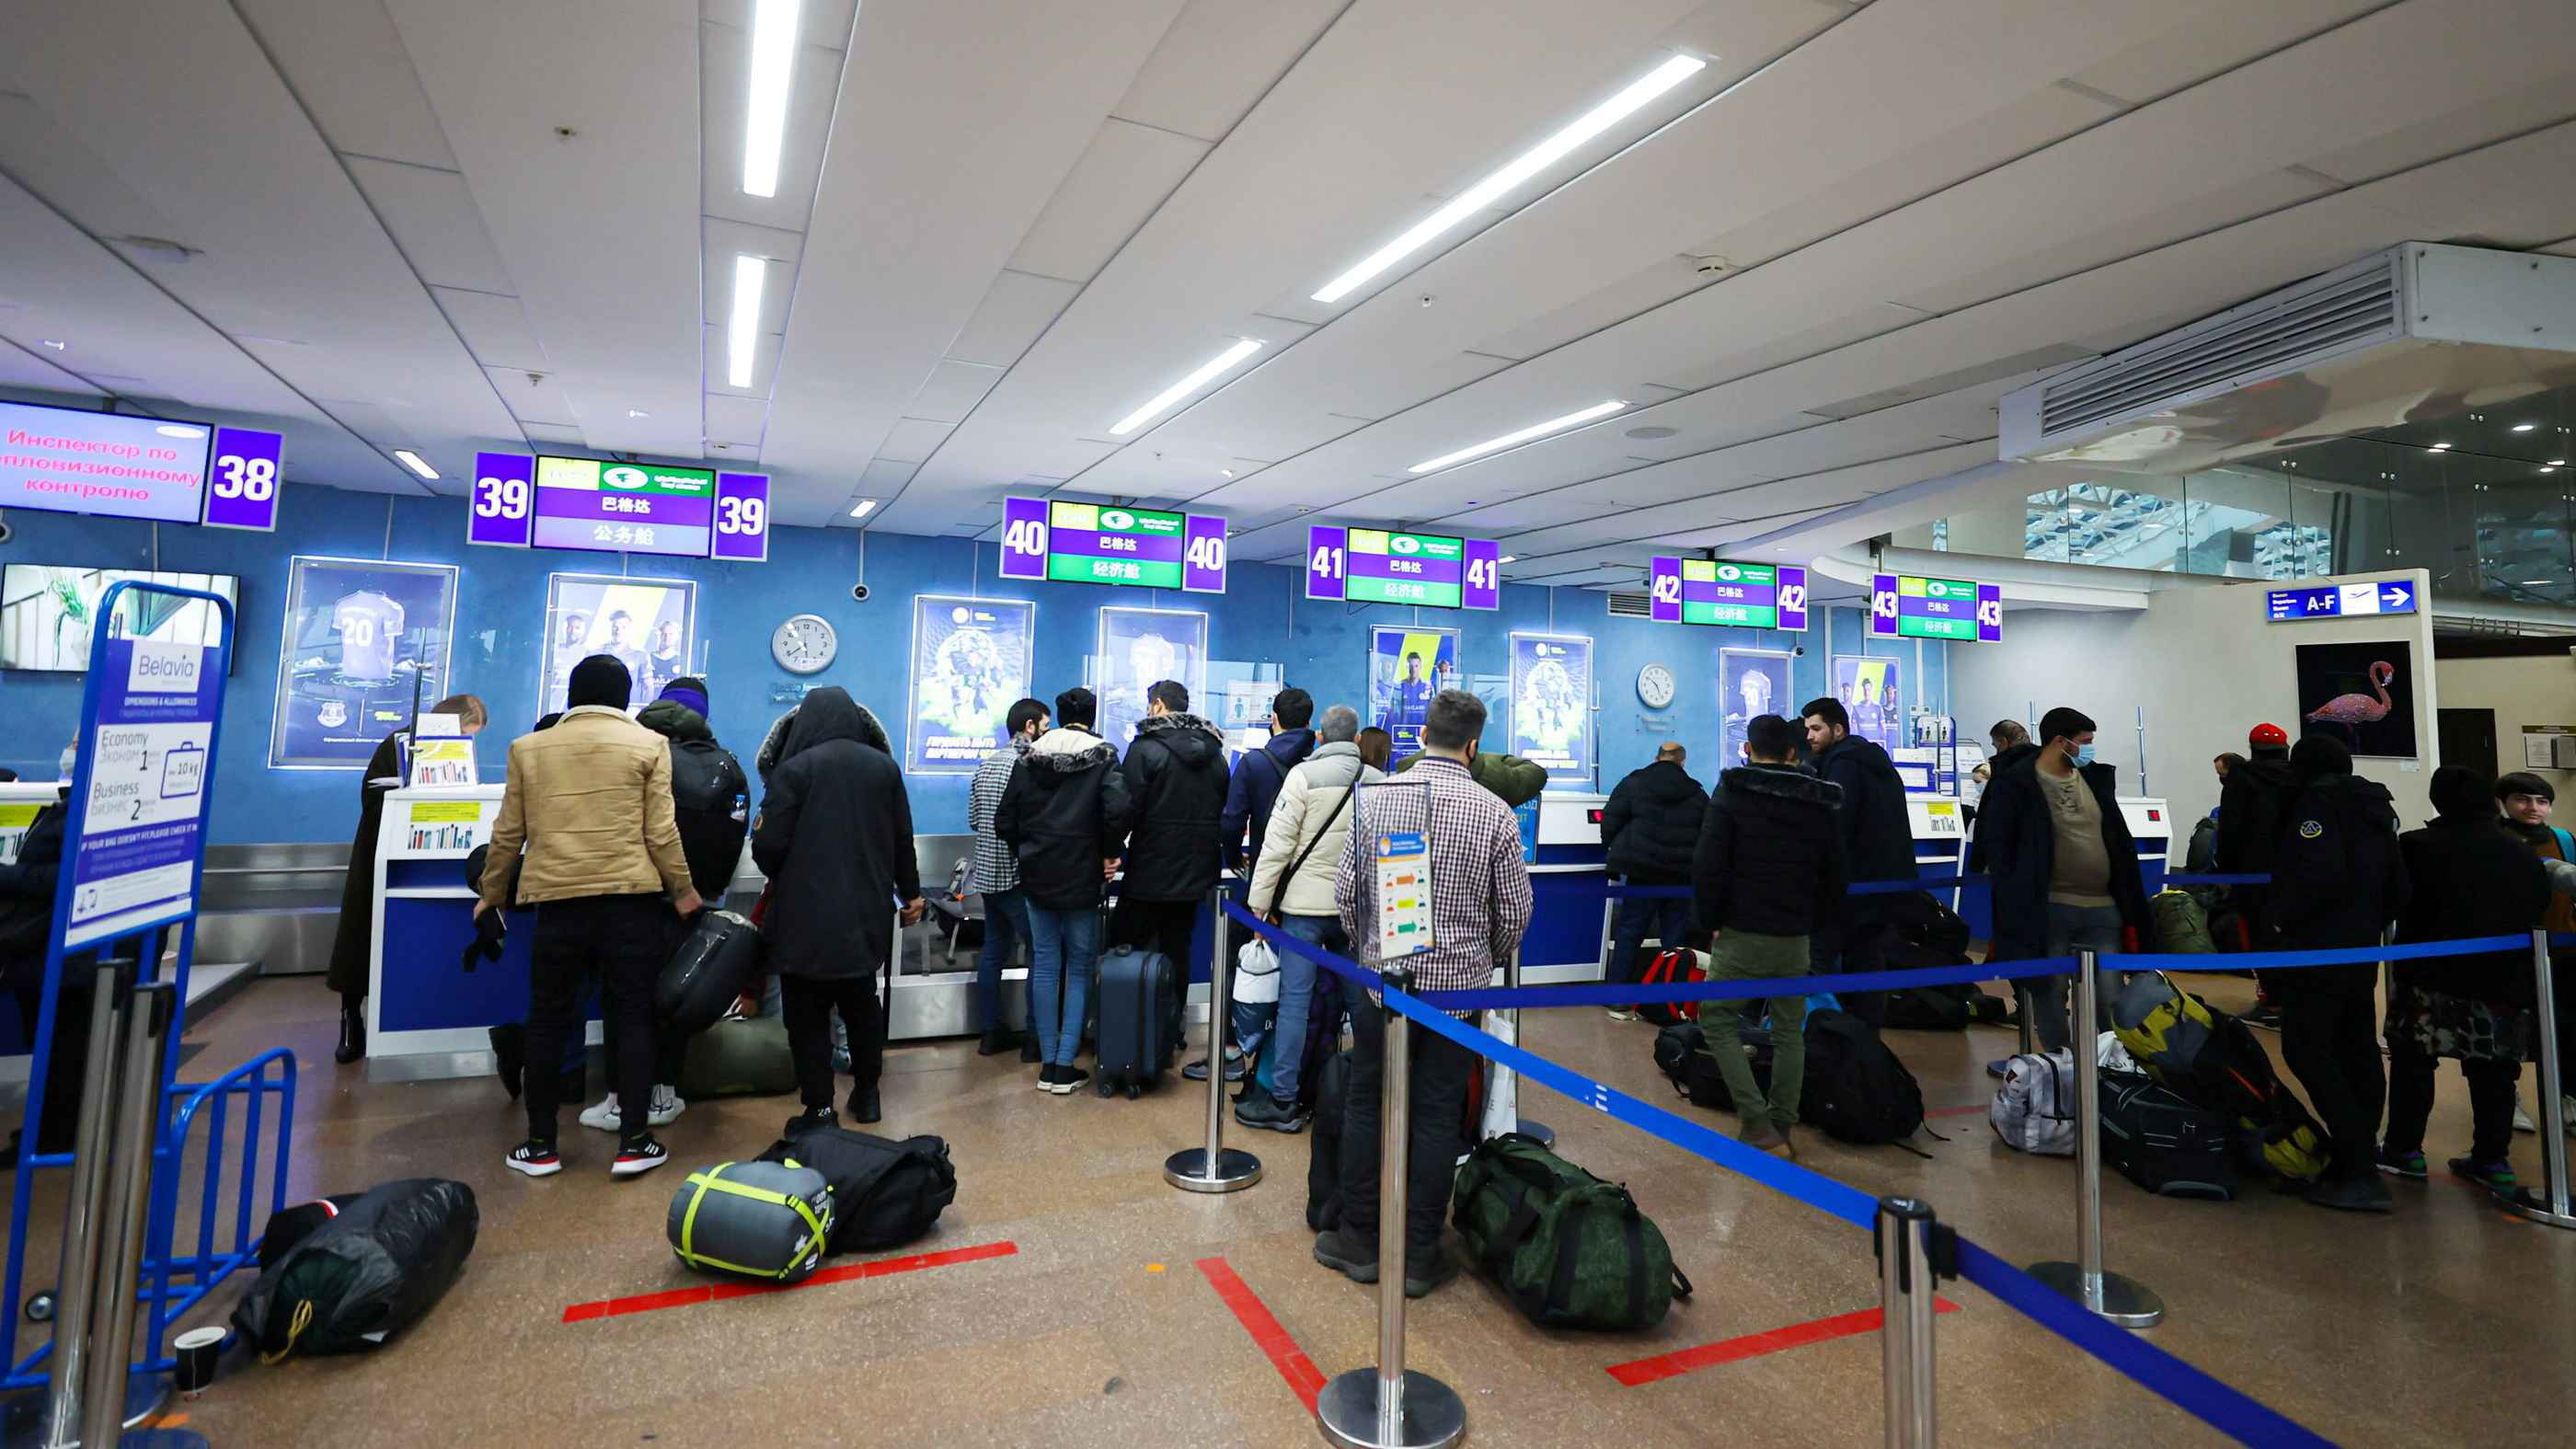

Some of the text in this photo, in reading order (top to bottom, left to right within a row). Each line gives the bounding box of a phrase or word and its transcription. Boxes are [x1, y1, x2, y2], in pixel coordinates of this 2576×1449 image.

[7, 430, 178, 461] Инспектор по
[25, 478, 149, 501] контролю
[213, 454, 275, 501] 38
[476, 477, 529, 520] 39
[602, 497, 651, 514] 巴格达
[719, 497, 765, 535] 39
[593, 524, 655, 546] 公务舱
[1005, 520, 1045, 556] 40
[1099, 536, 1137, 552] 巴格达
[1187, 536, 1224, 570] 40
[1311, 546, 1343, 579] 41
[1466, 558, 1496, 590] 41
[1652, 574, 1680, 604] 42
[1779, 584, 1805, 613] 42
[2307, 594, 2335, 611] A-F
[1873, 591, 1896, 618] 43
[1979, 600, 2000, 627] 43
[341, 617, 373, 648] 20
[138, 654, 194, 677] Belavia
[102, 730, 149, 747] Economy
[140, 750, 147, 771] 1
[94, 782, 139, 799] Business
[131, 799, 141, 821] 2
